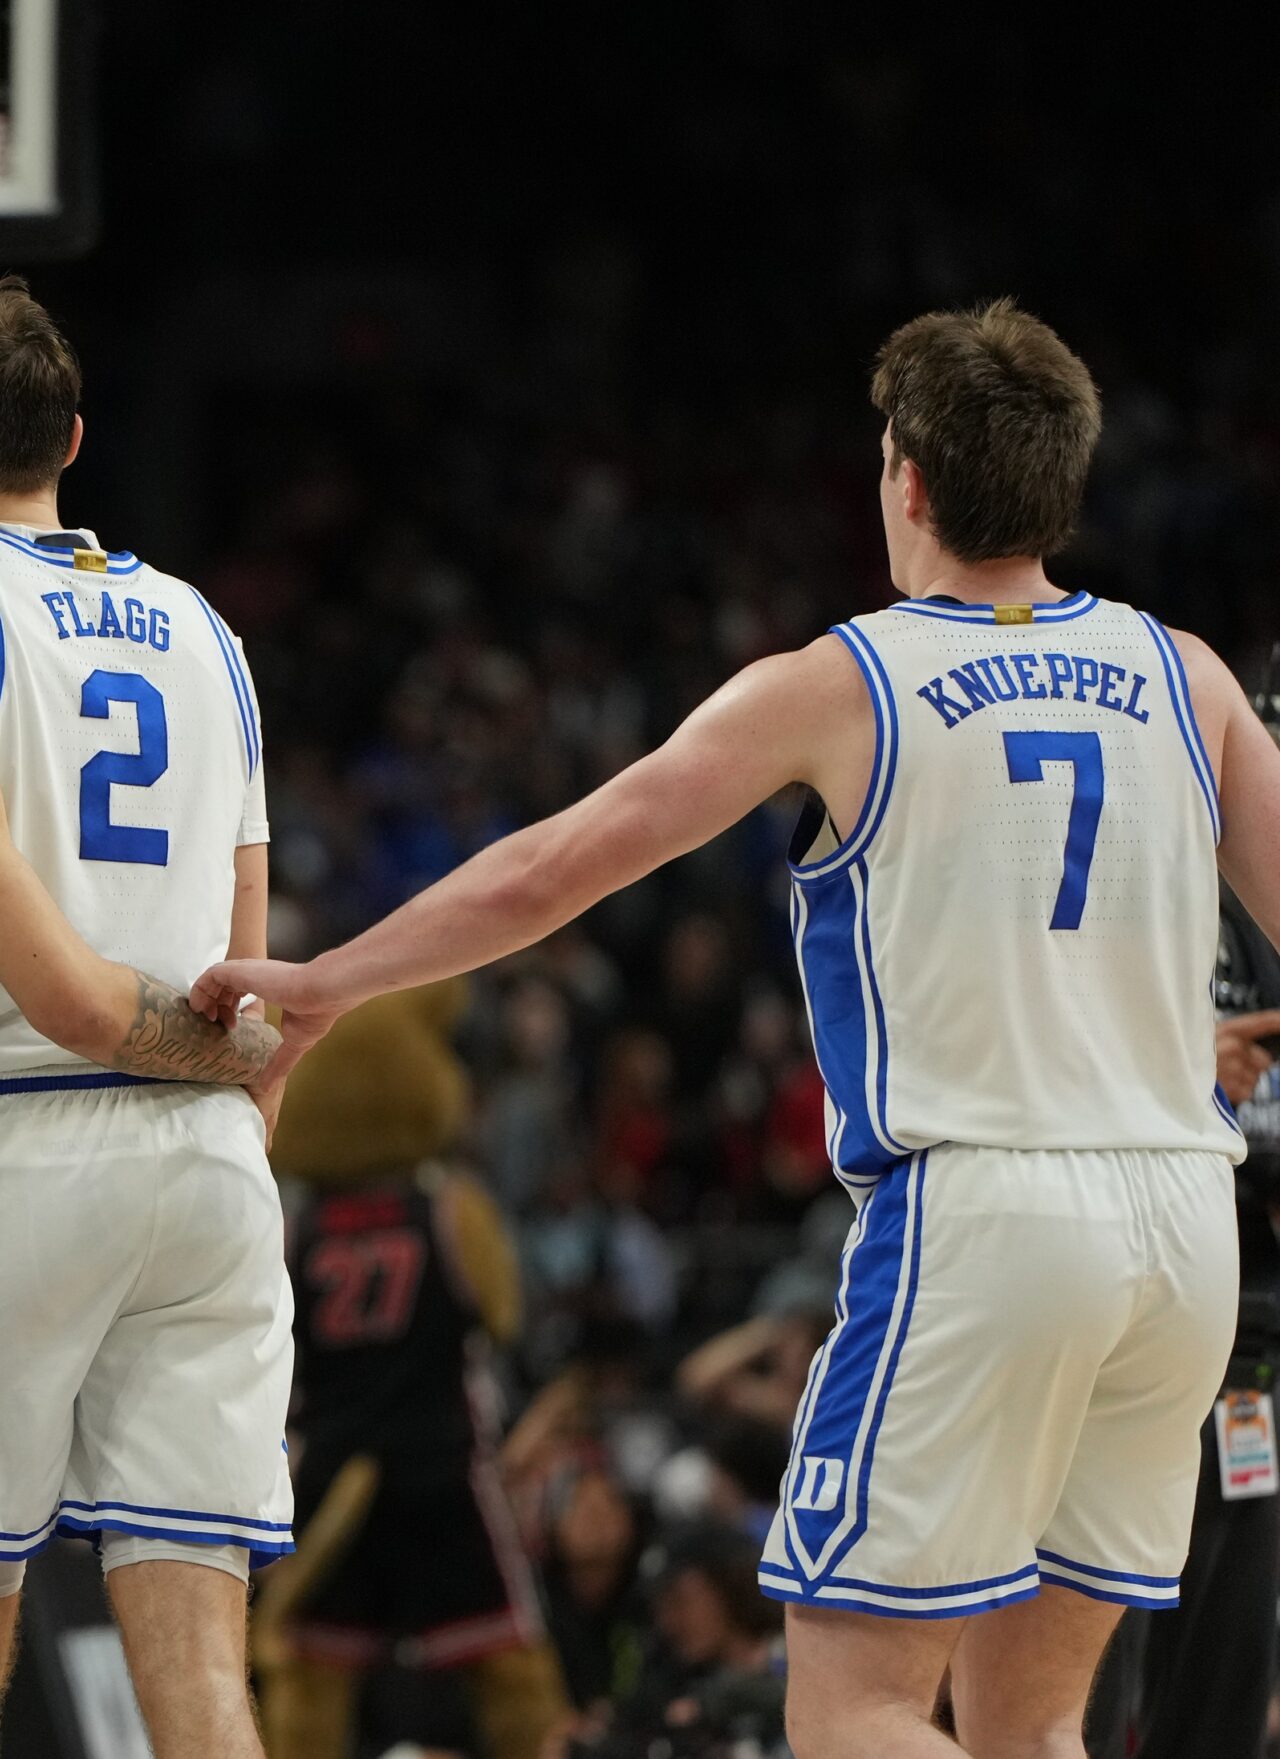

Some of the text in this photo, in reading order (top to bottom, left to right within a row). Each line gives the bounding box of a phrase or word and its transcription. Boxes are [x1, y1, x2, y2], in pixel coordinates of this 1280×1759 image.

[41, 592, 170, 652] FLAGG
[917, 653, 1148, 729] KNUEPPEL
[79, 670, 168, 866] 2
[1002, 731, 1105, 931] 7
[307, 1231, 422, 1340] 27
